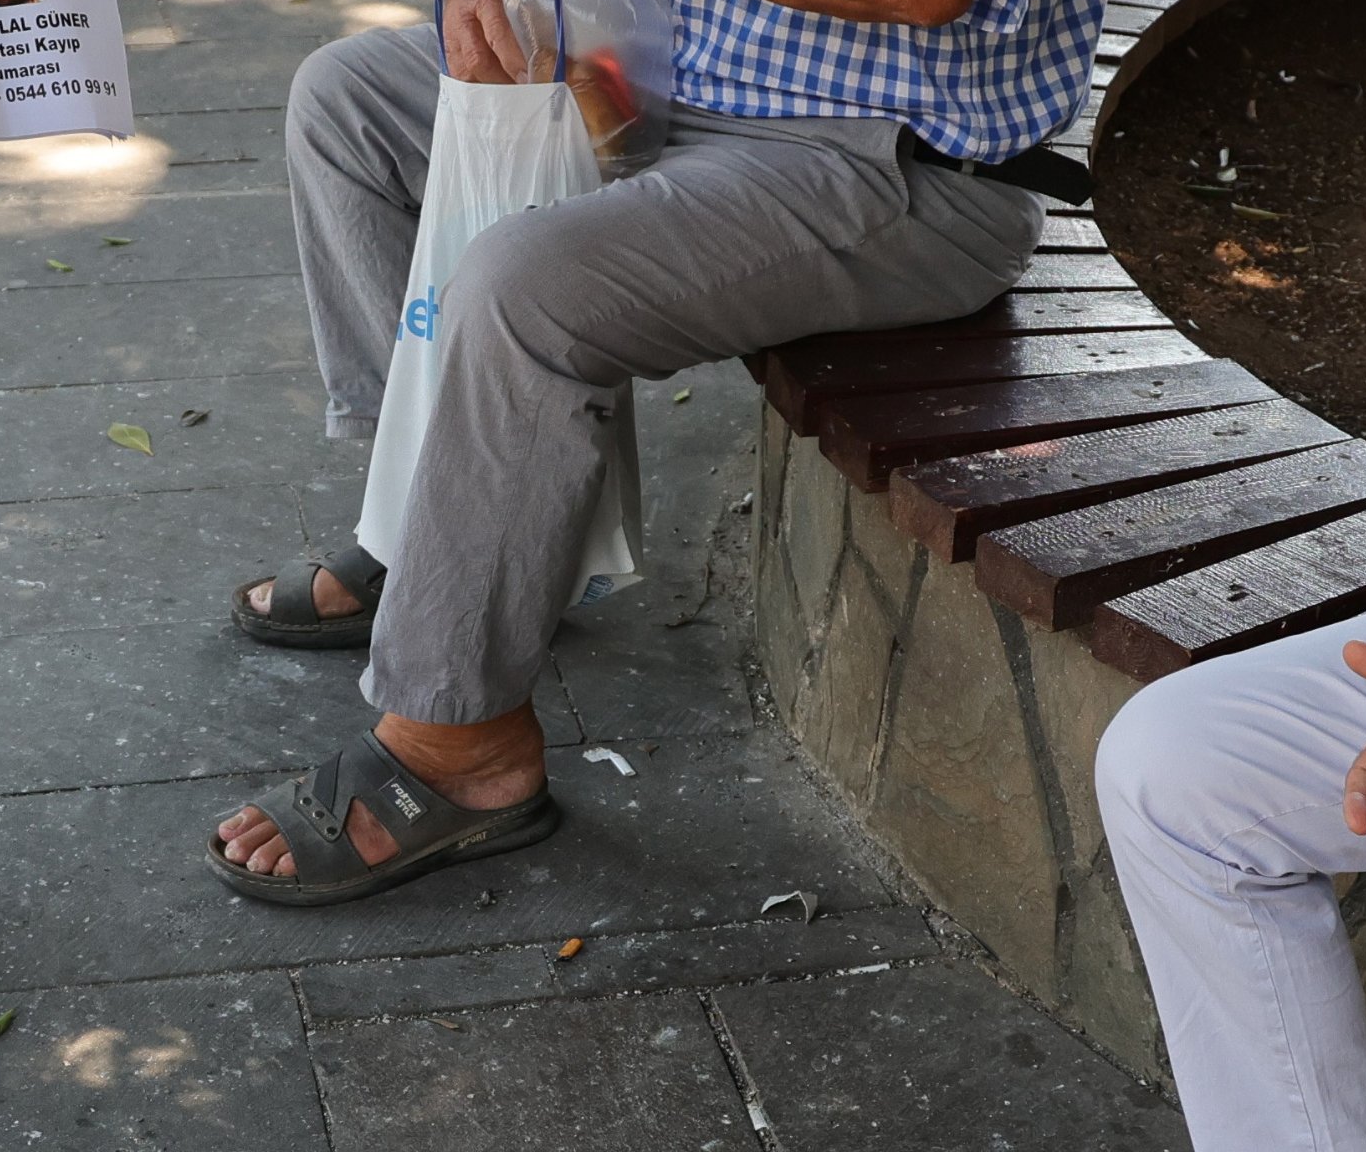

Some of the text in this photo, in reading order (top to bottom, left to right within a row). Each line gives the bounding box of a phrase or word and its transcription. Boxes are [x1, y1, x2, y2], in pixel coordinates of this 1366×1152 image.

[36, 11, 90, 29] GÜNER
[35, 37, 81, 53] Kayıp
[6, 85, 46, 103] 0544
[52, 79, 81, 96] 610
[86, 79, 102, 94] 99
[104, 80, 117, 97] 91
[457, 831, 488, 849] SPORT
